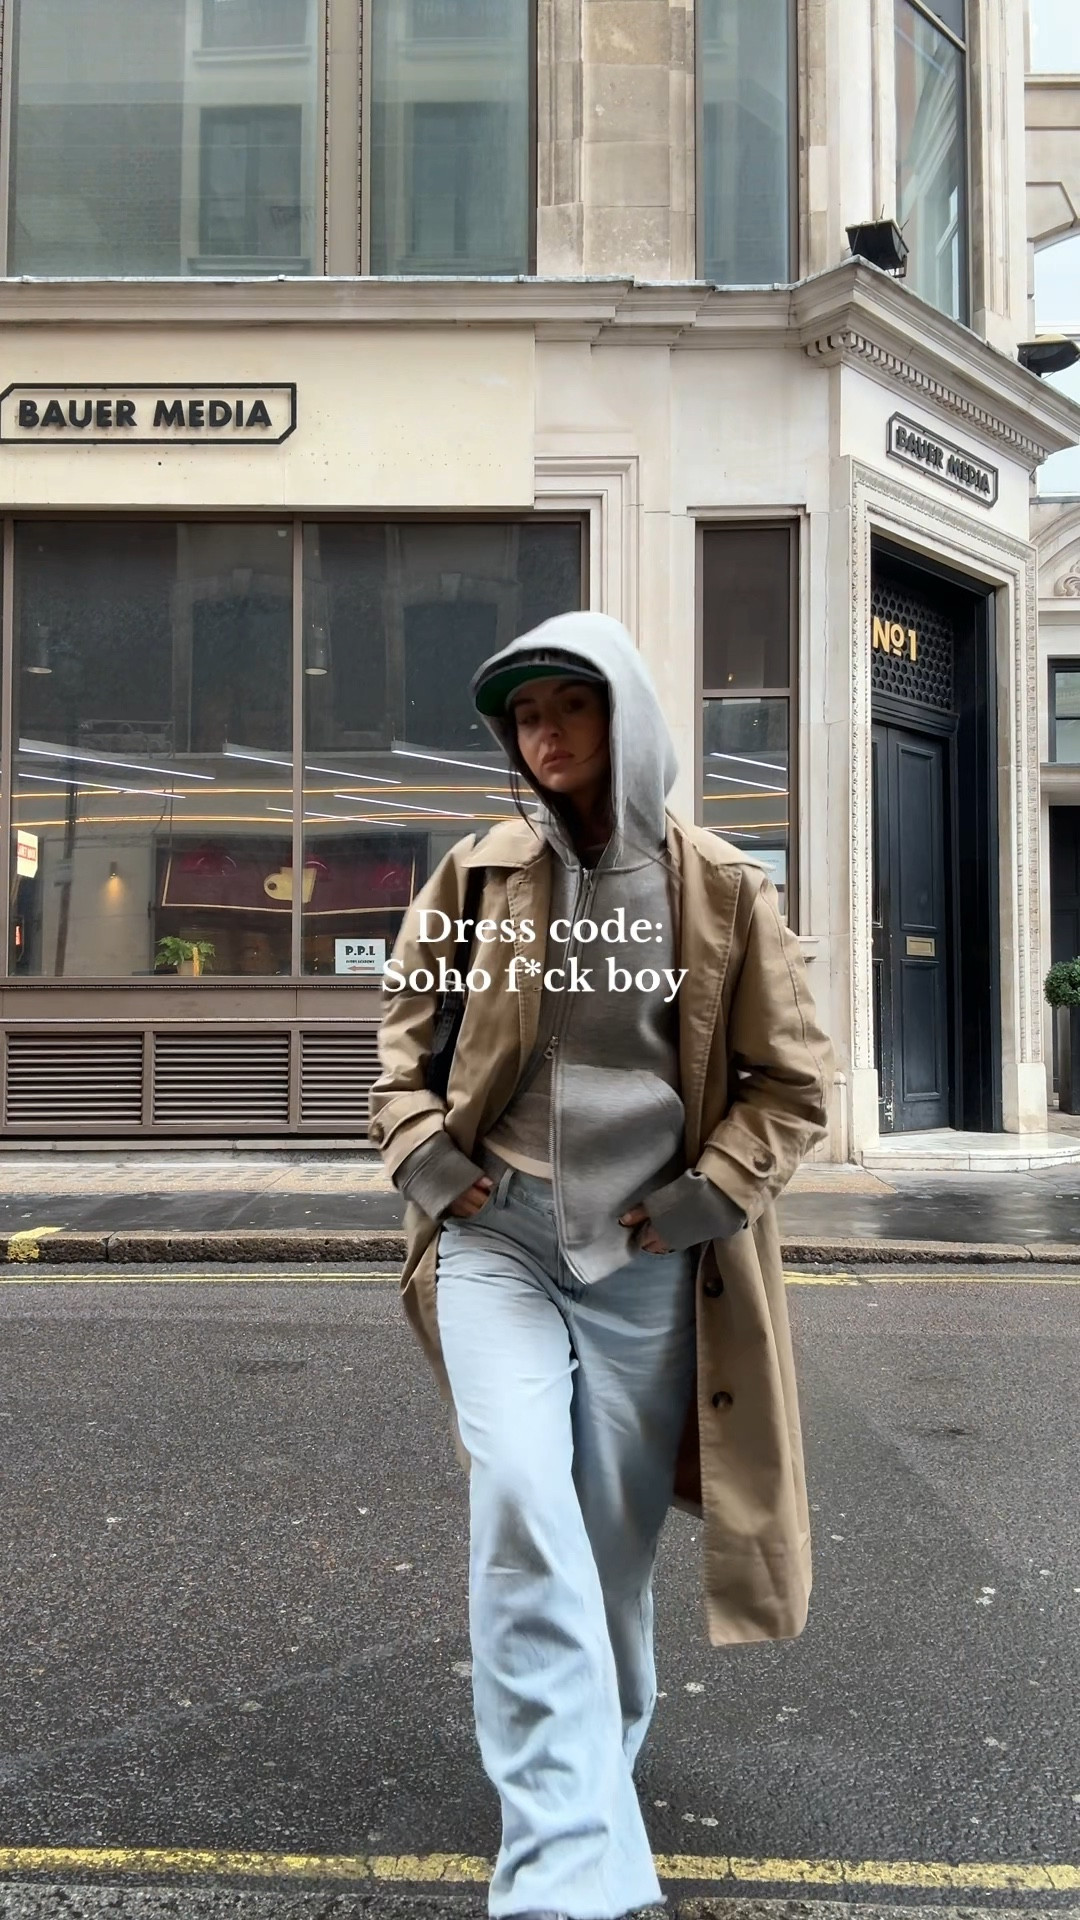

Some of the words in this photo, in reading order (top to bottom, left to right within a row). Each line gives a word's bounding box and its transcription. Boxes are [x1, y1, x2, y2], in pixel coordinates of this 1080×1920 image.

[18, 400, 138, 427] BAUER
[152, 400, 272, 427] MEDIA
[895, 425, 944, 470] BAUER
[946, 454, 991, 495] MEDIA
[345, 945, 376, 956] P.P.L
